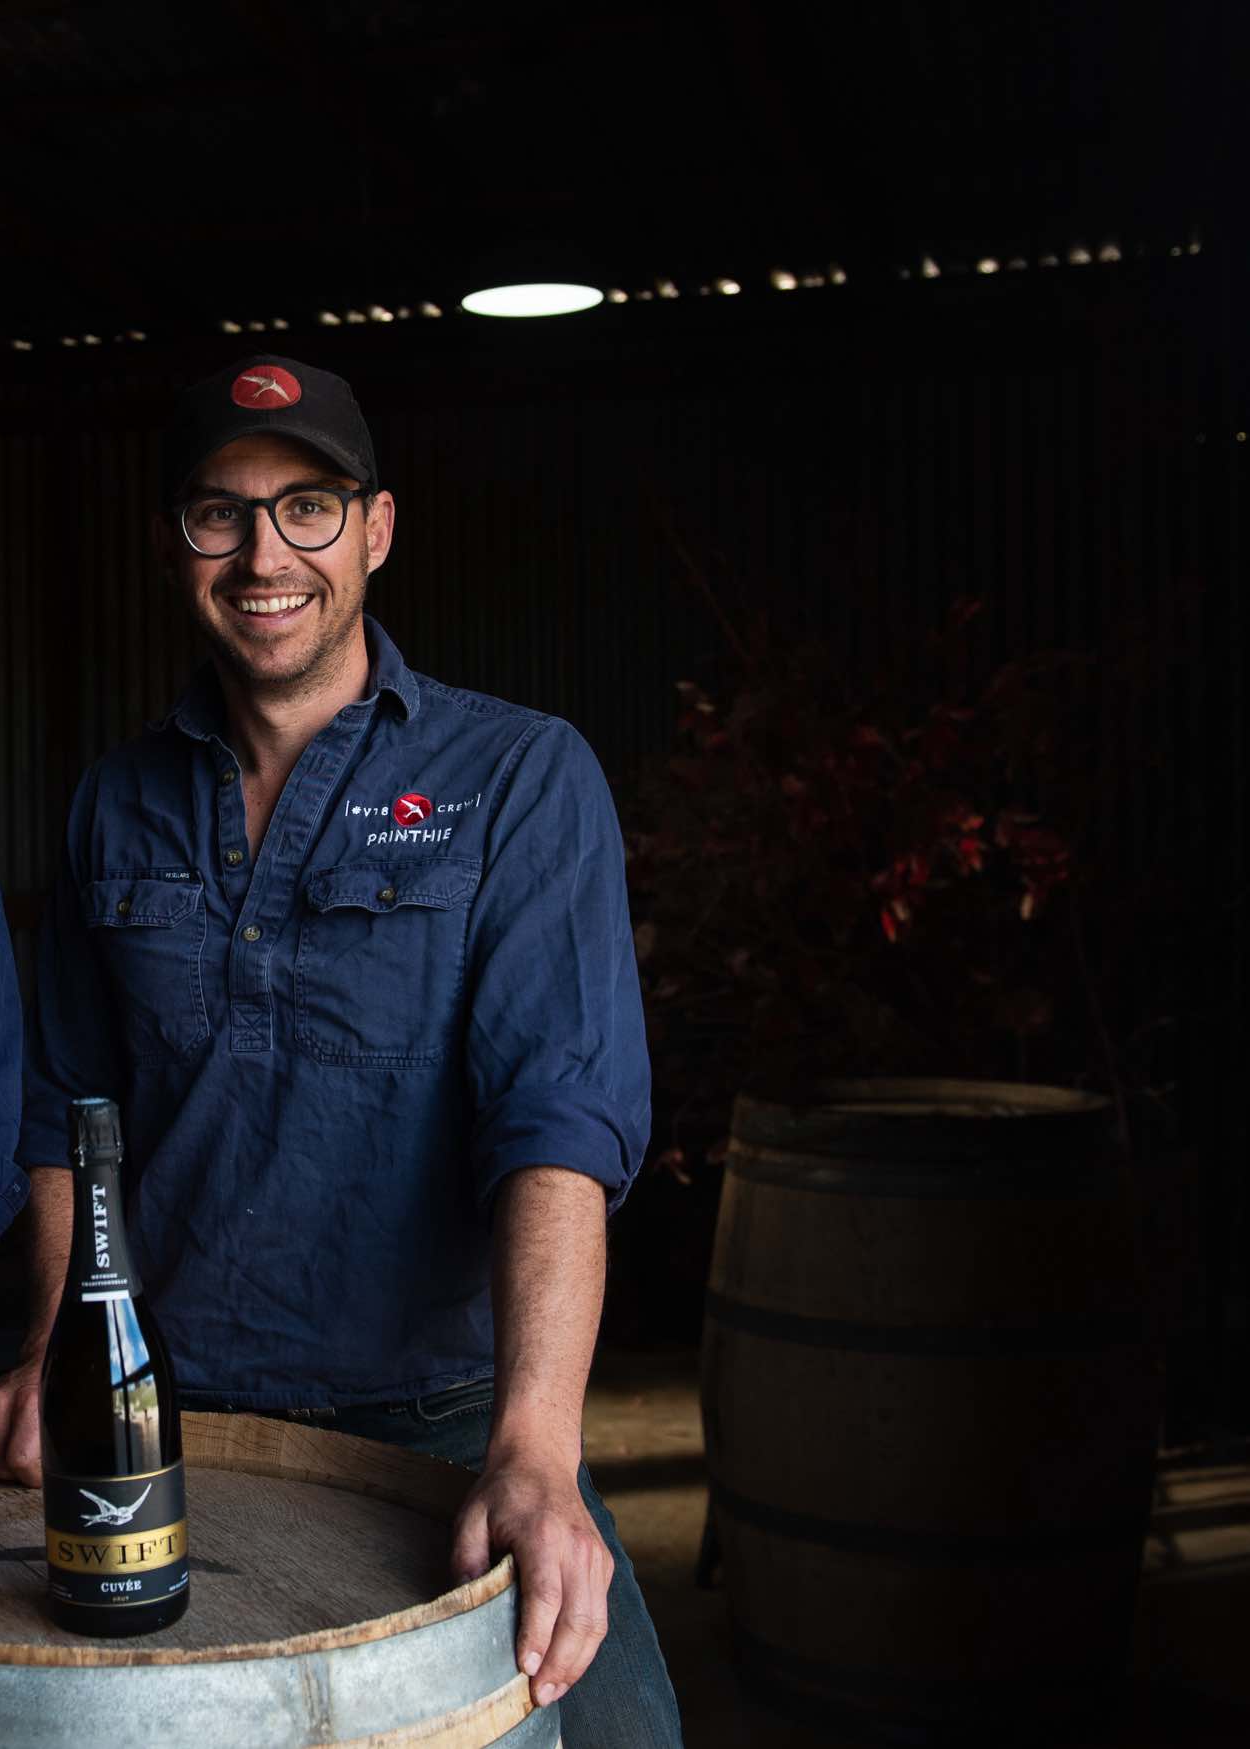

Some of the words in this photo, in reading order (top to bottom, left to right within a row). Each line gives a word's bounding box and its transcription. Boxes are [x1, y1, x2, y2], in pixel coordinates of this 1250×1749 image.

[367, 827, 452, 846] PRINTHIE
[92, 1184, 110, 1268] SWIFT
[57, 1533, 179, 1565] SWIFT
[101, 1578, 142, 1592] CUVÉE
